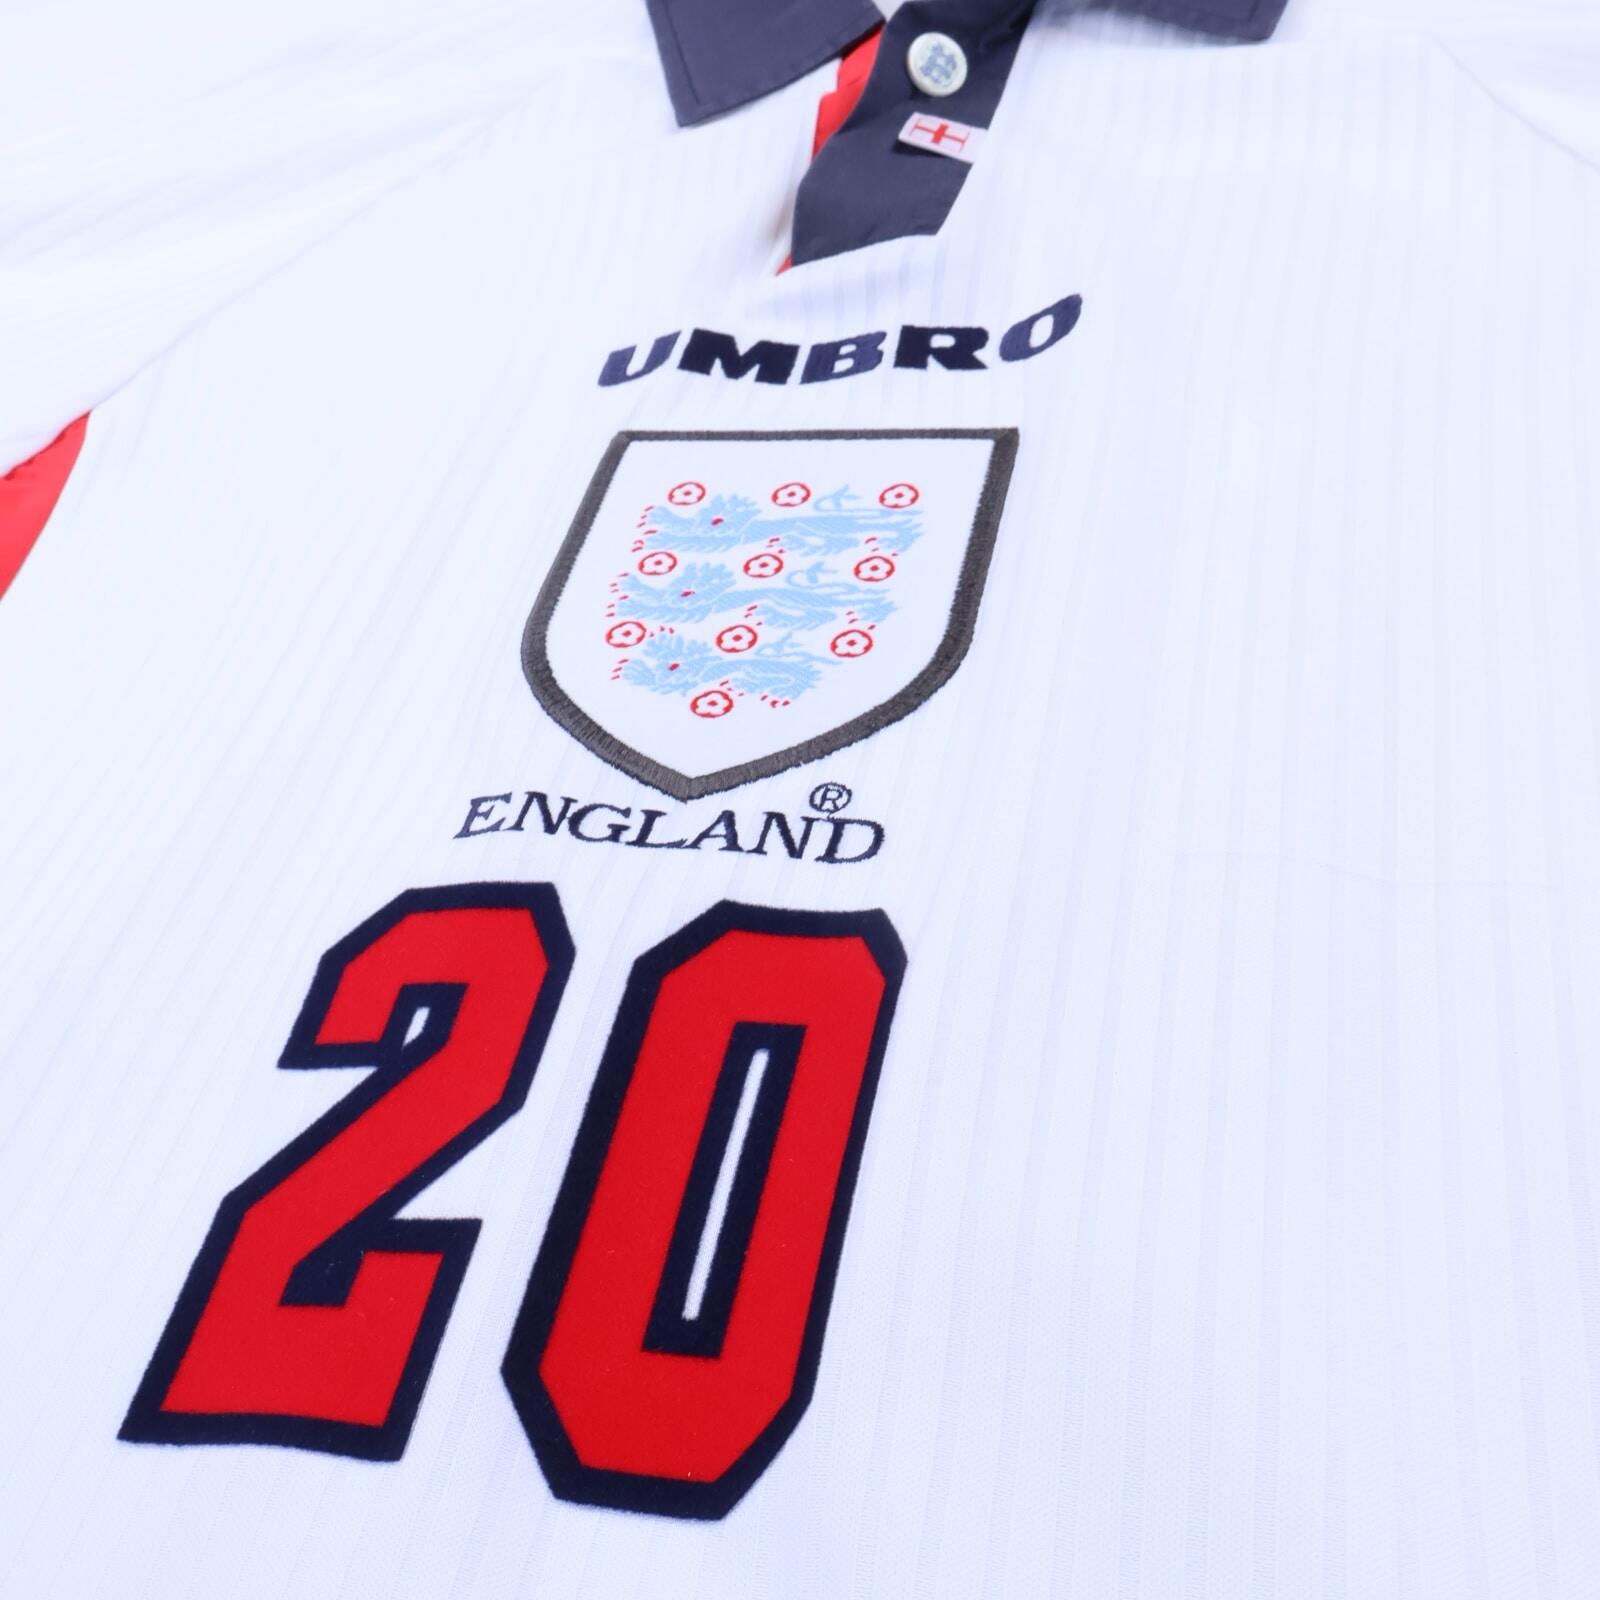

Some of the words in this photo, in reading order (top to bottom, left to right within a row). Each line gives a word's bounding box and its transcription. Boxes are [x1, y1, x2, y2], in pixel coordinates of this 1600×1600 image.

[598, 294, 1083, 387] UMBRO
[453, 791, 885, 864] ENGLAND
[117, 881, 908, 1522] 20
